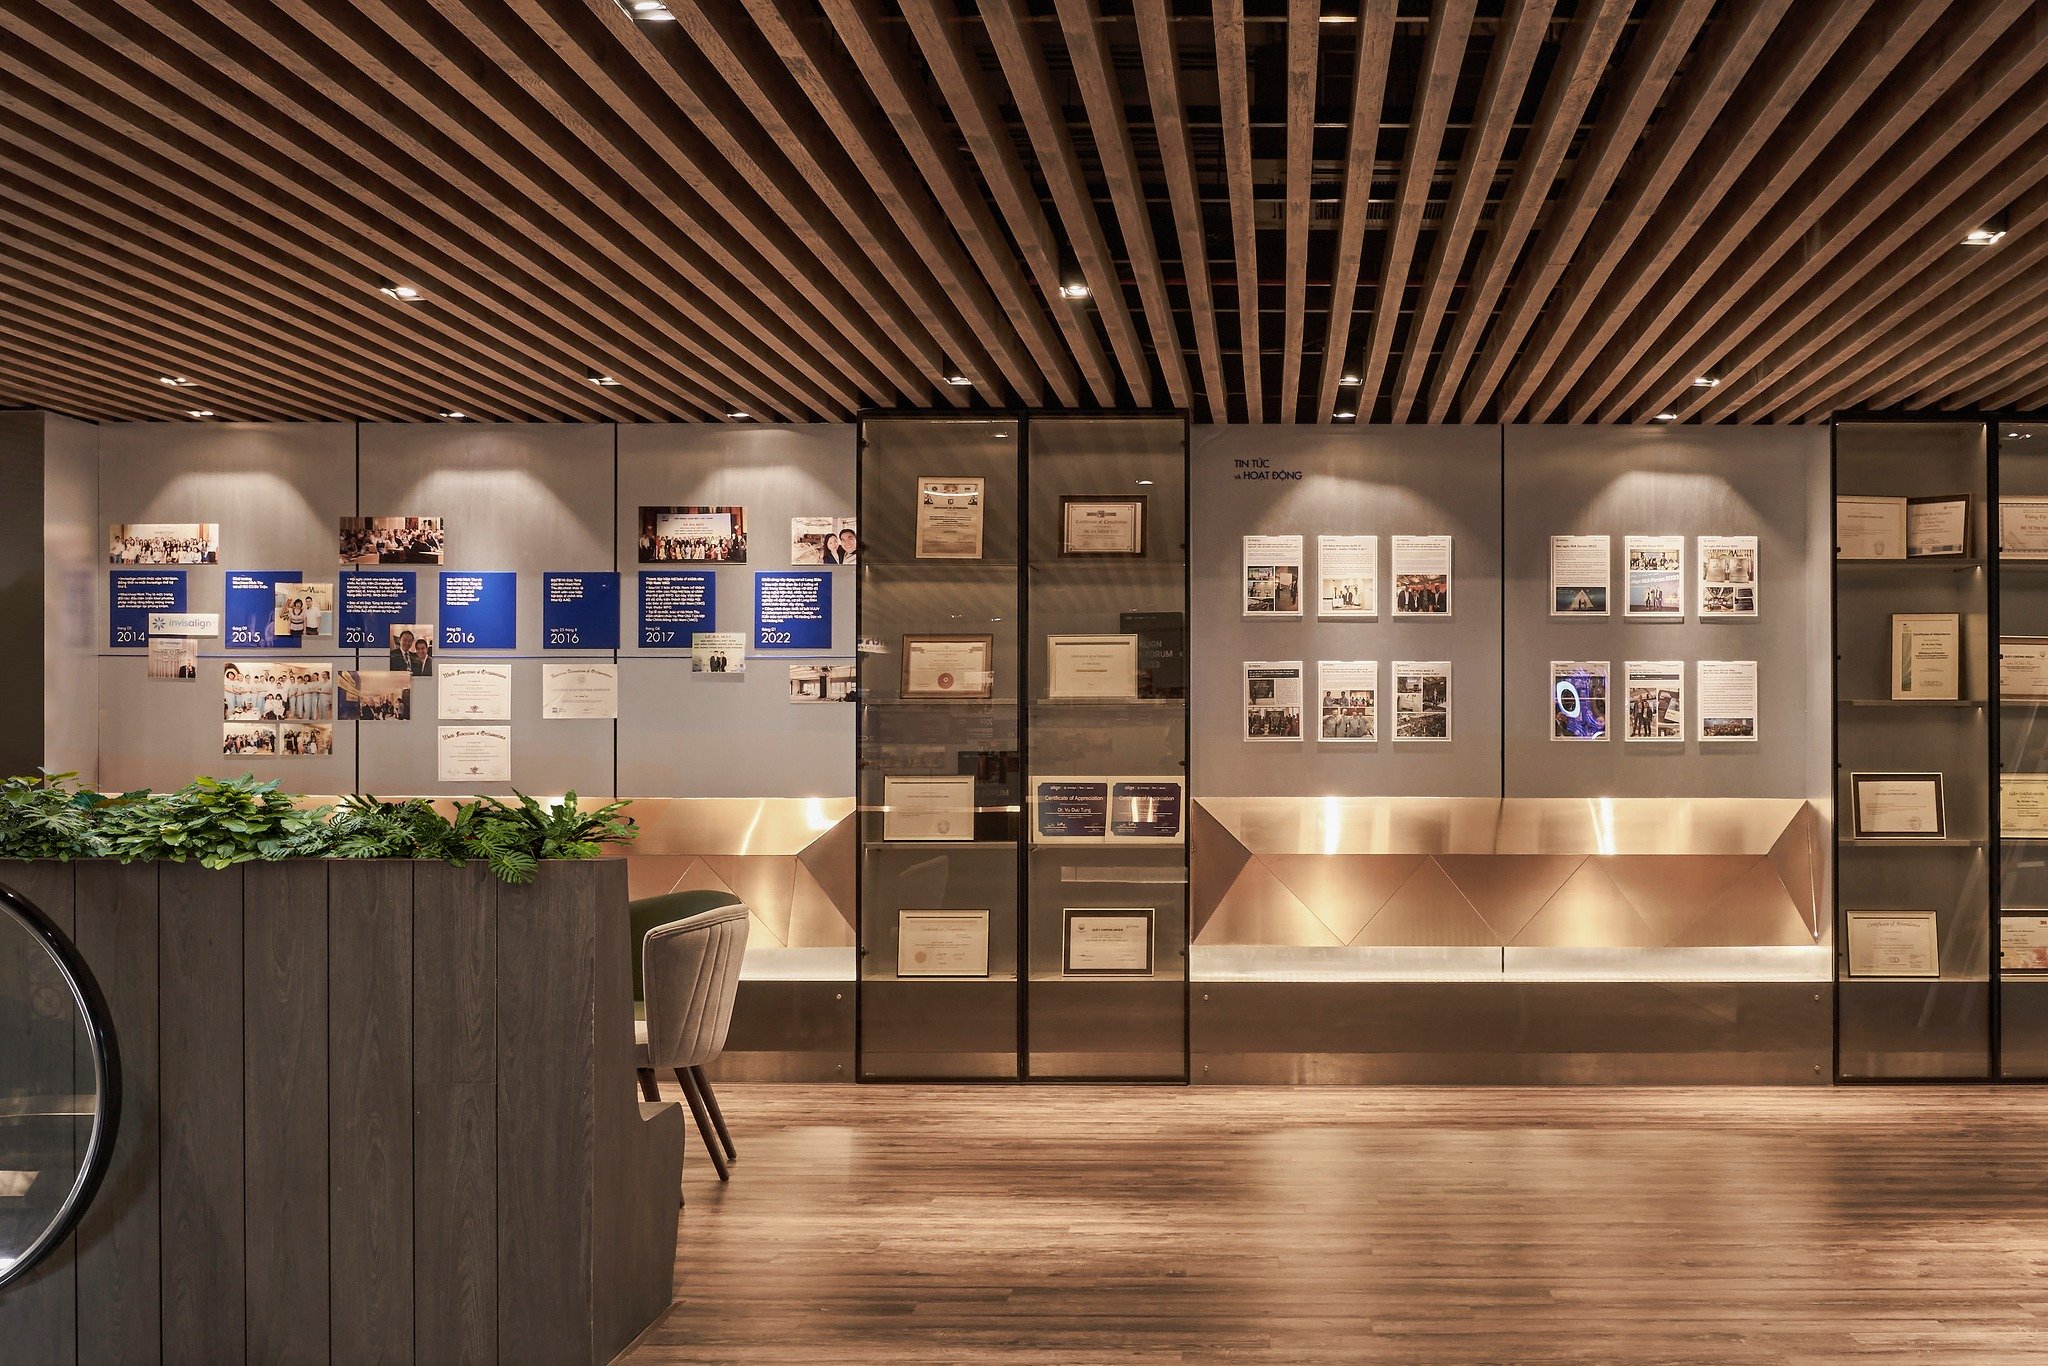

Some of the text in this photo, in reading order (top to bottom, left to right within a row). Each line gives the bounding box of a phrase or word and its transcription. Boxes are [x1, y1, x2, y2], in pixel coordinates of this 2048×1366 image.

[1234, 457, 1270, 469] TIN TỨC
[1243, 471, 1270, 481] HOẠT
[1271, 469, 1303, 482] ĐỘNG
[169, 620, 212, 629] invisalign
[117, 632, 145, 642] 2014
[232, 632, 261, 643] 2015
[346, 632, 375, 643] 2016
[446, 632, 475, 643] 2016
[550, 633, 580, 644] 2016
[645, 632, 675, 643] 2017
[761, 632, 791, 643] 2022
